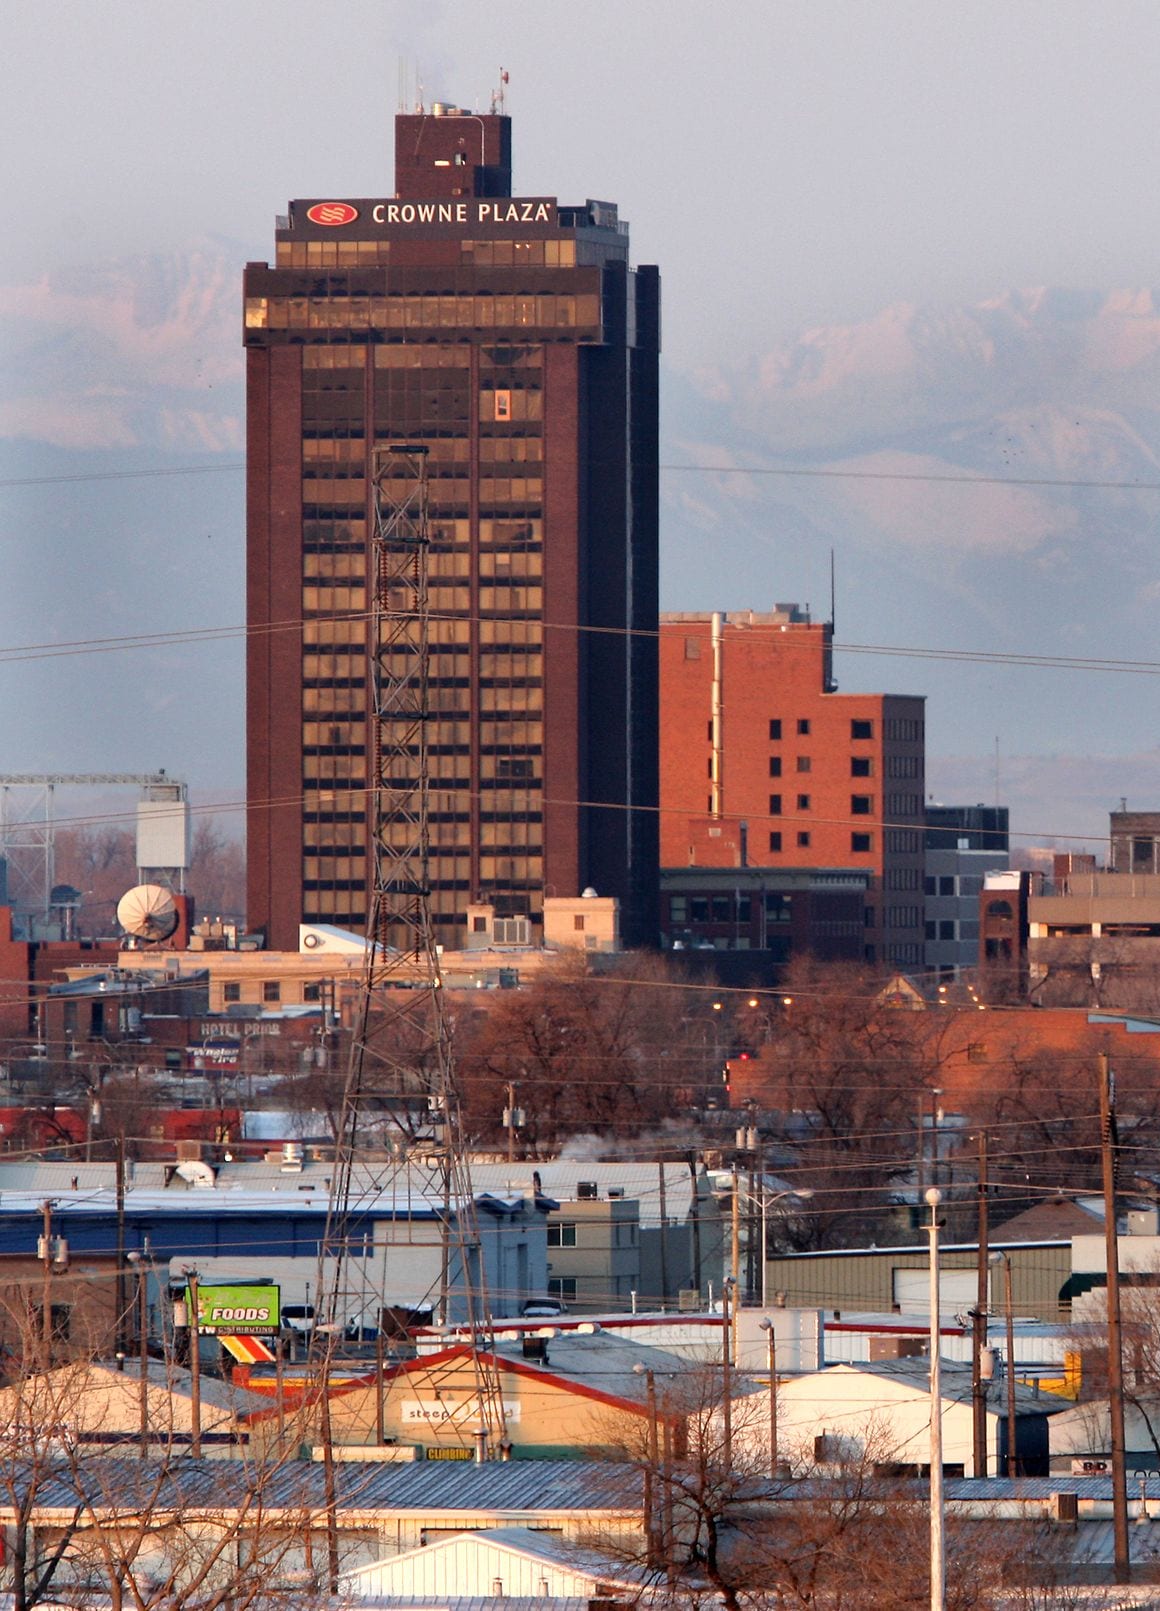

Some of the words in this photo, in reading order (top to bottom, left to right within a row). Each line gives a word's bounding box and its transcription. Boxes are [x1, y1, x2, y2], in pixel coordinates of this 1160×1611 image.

[372, 204, 467, 223] CROWNE
[478, 203, 549, 222] PLAZA
[201, 1023, 240, 1036] HOTEL
[244, 1023, 281, 1035] PRIOR
[211, 1307, 270, 1321] FOODS
[410, 1407, 450, 1420] steep
